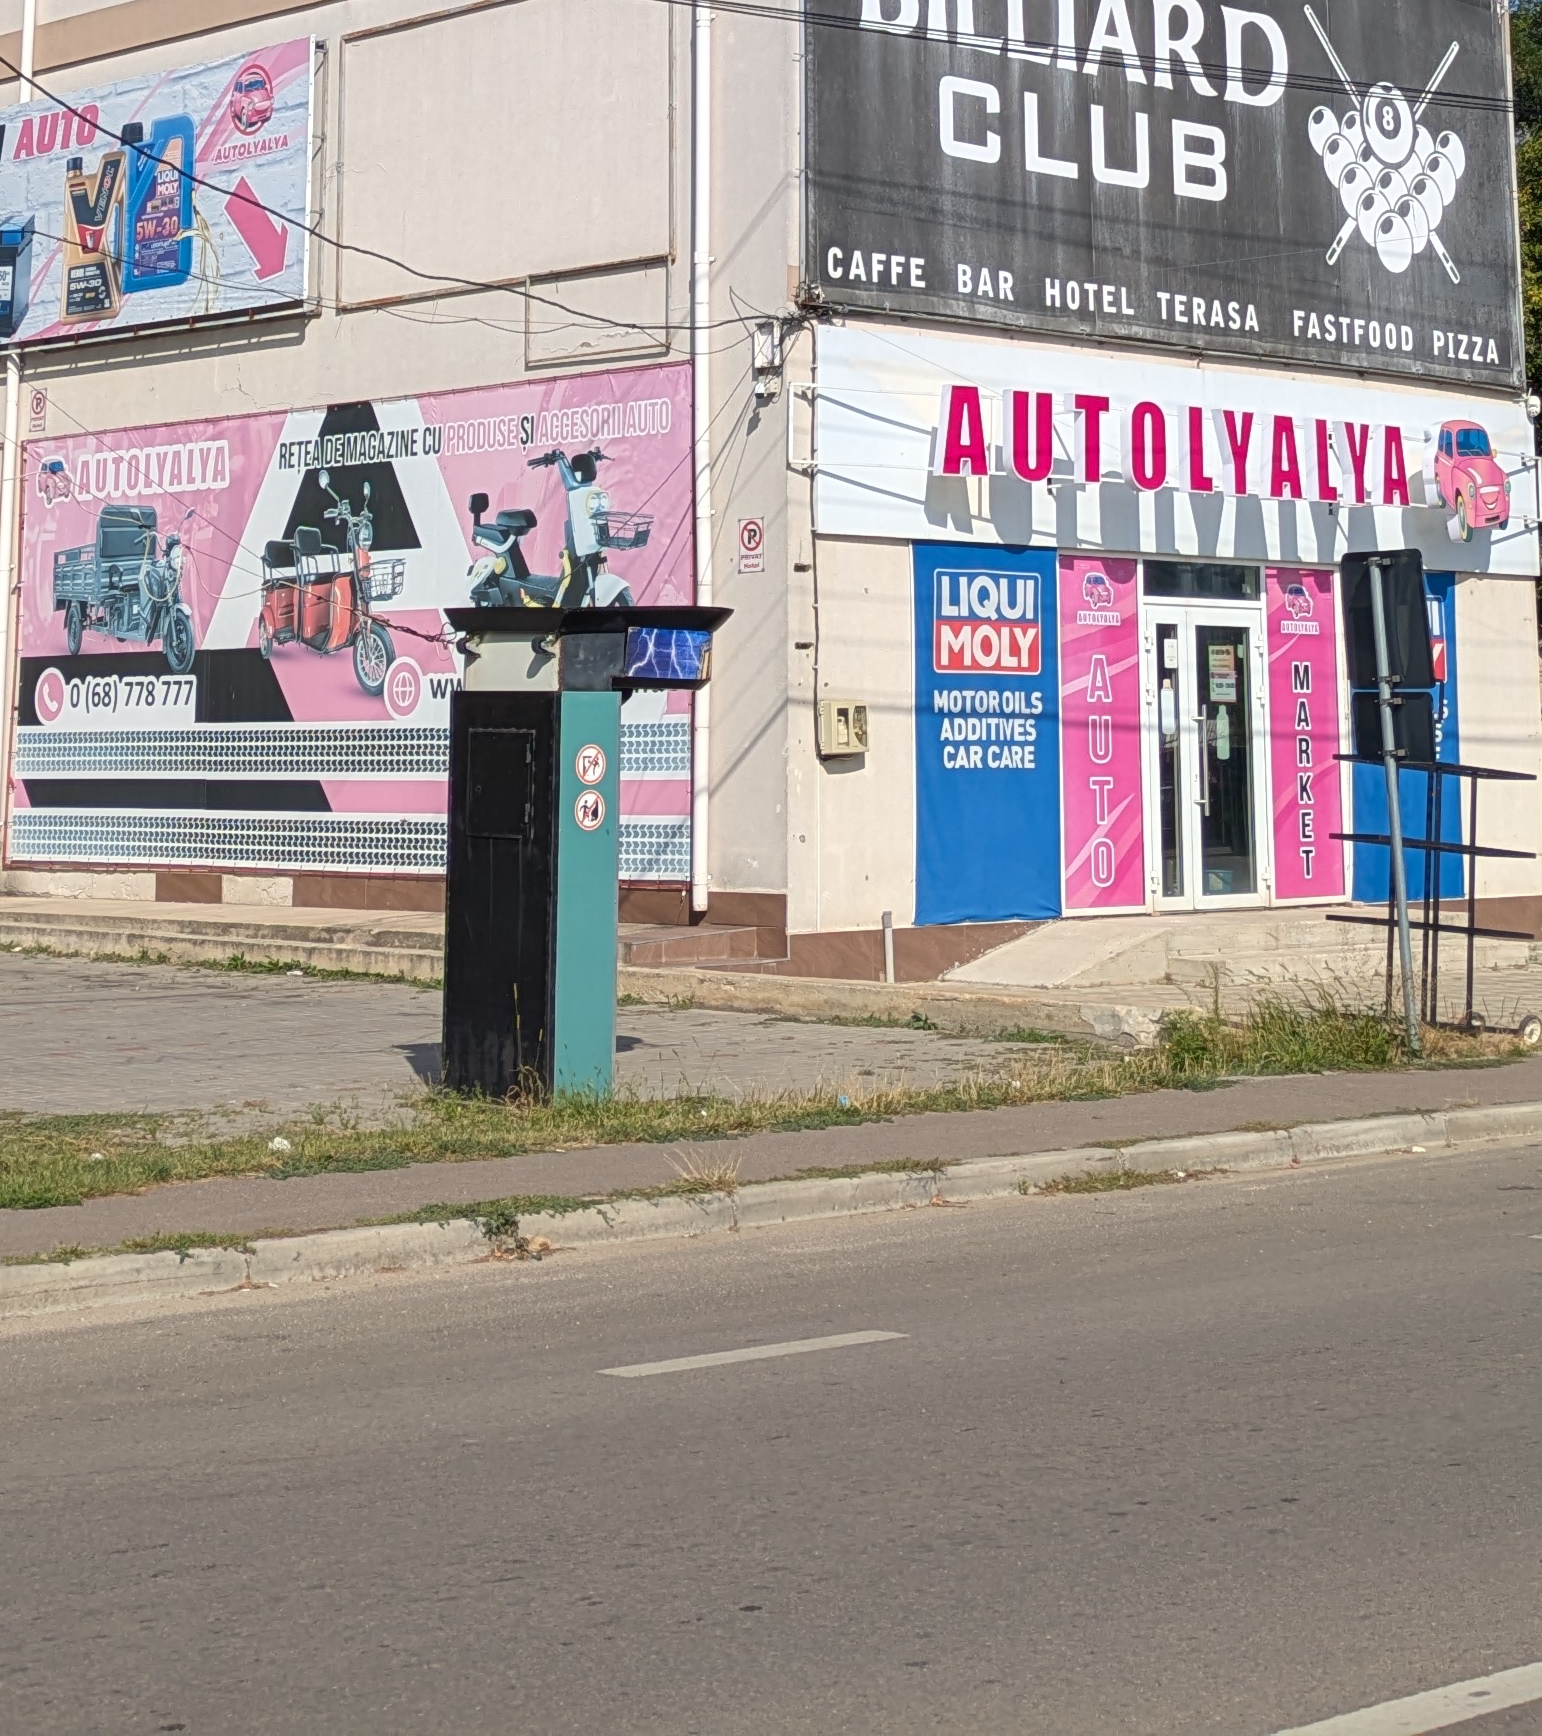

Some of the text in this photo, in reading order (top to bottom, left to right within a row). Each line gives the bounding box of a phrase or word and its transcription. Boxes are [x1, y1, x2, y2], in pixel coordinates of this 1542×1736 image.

[12, 103, 100, 161] AUTO
[214, 134, 289, 163] AUTOLYALYA
[939, 75, 1227, 201] CLUB
[157, 170, 178, 183] LIQUI
[157, 182, 179, 196] MOLY
[136, 215, 179, 241] 5W-30
[827, 246, 1499, 365] CAFFE BAR HOTEL TERASA FASTFOOD PIZZA
[325, 436, 344, 466] DE
[346, 428, 418, 463] MAGAZINE
[422, 426, 442, 455] CU
[446, 417, 517, 454] PRODUSE
[539, 406, 622, 444] ACCESORII
[625, 400, 671, 436] AUTO
[937, 385, 1411, 508] AUTOLYALYA
[76, 444, 228, 497] AUTOLYALYA
[941, 575, 1035, 621] LIQUI
[941, 624, 1038, 668] MOLY
[70, 680, 194, 714] 0 (68) 778 777
[934, 690, 1043, 715] MOTOR OILS
[940, 717, 1037, 742] ADDITIVES
[943, 745, 1036, 769] CAR CARE
[1087, 654, 1115, 887] AUTO
[1292, 661, 1315, 879] MARKET
